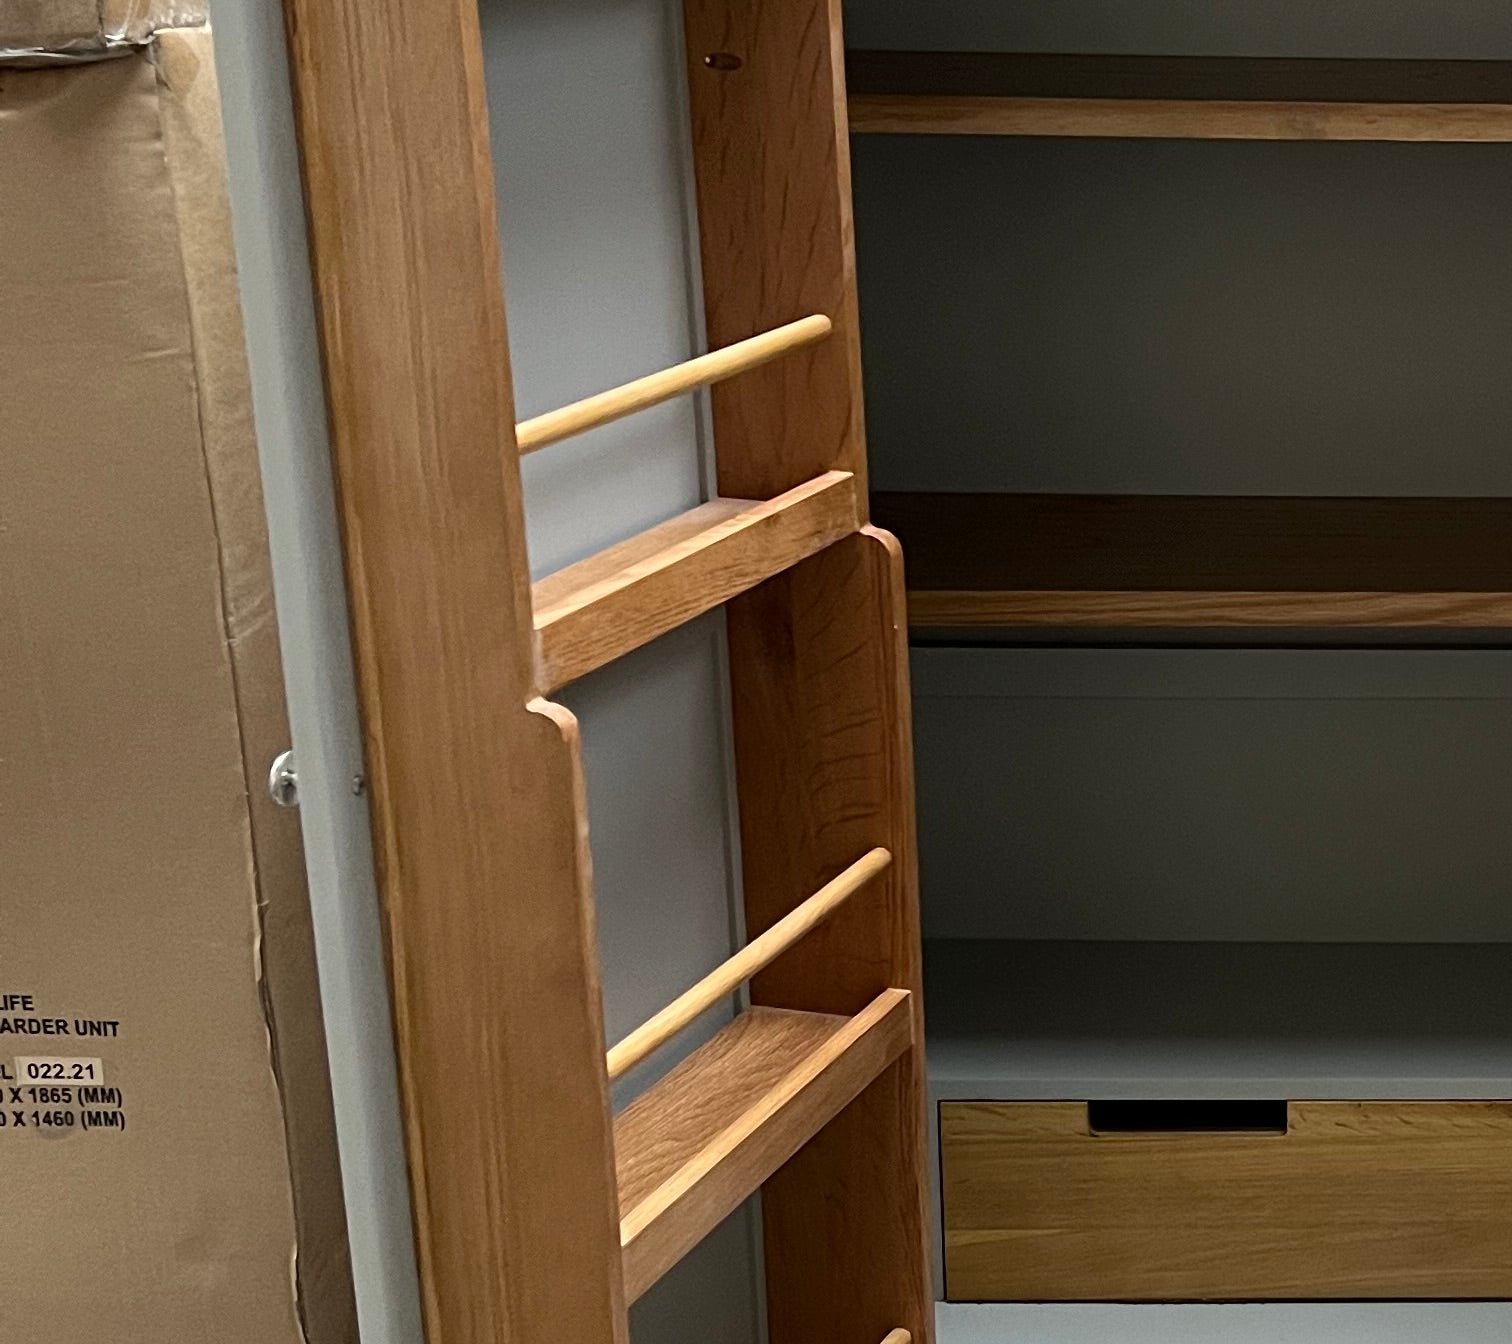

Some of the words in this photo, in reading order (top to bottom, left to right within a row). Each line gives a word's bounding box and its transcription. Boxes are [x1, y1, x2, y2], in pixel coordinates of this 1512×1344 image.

[74, 1019, 119, 1037] UNIT
[27, 1063, 94, 1080] 022.21
[9, 1087, 23, 1103] X
[28, 1087, 72, 1104] 1865
[77, 1087, 122, 1108] (MM)
[12, 1110, 26, 1127] X
[31, 1110, 74, 1127] 1460
[80, 1110, 125, 1131] (MM)
